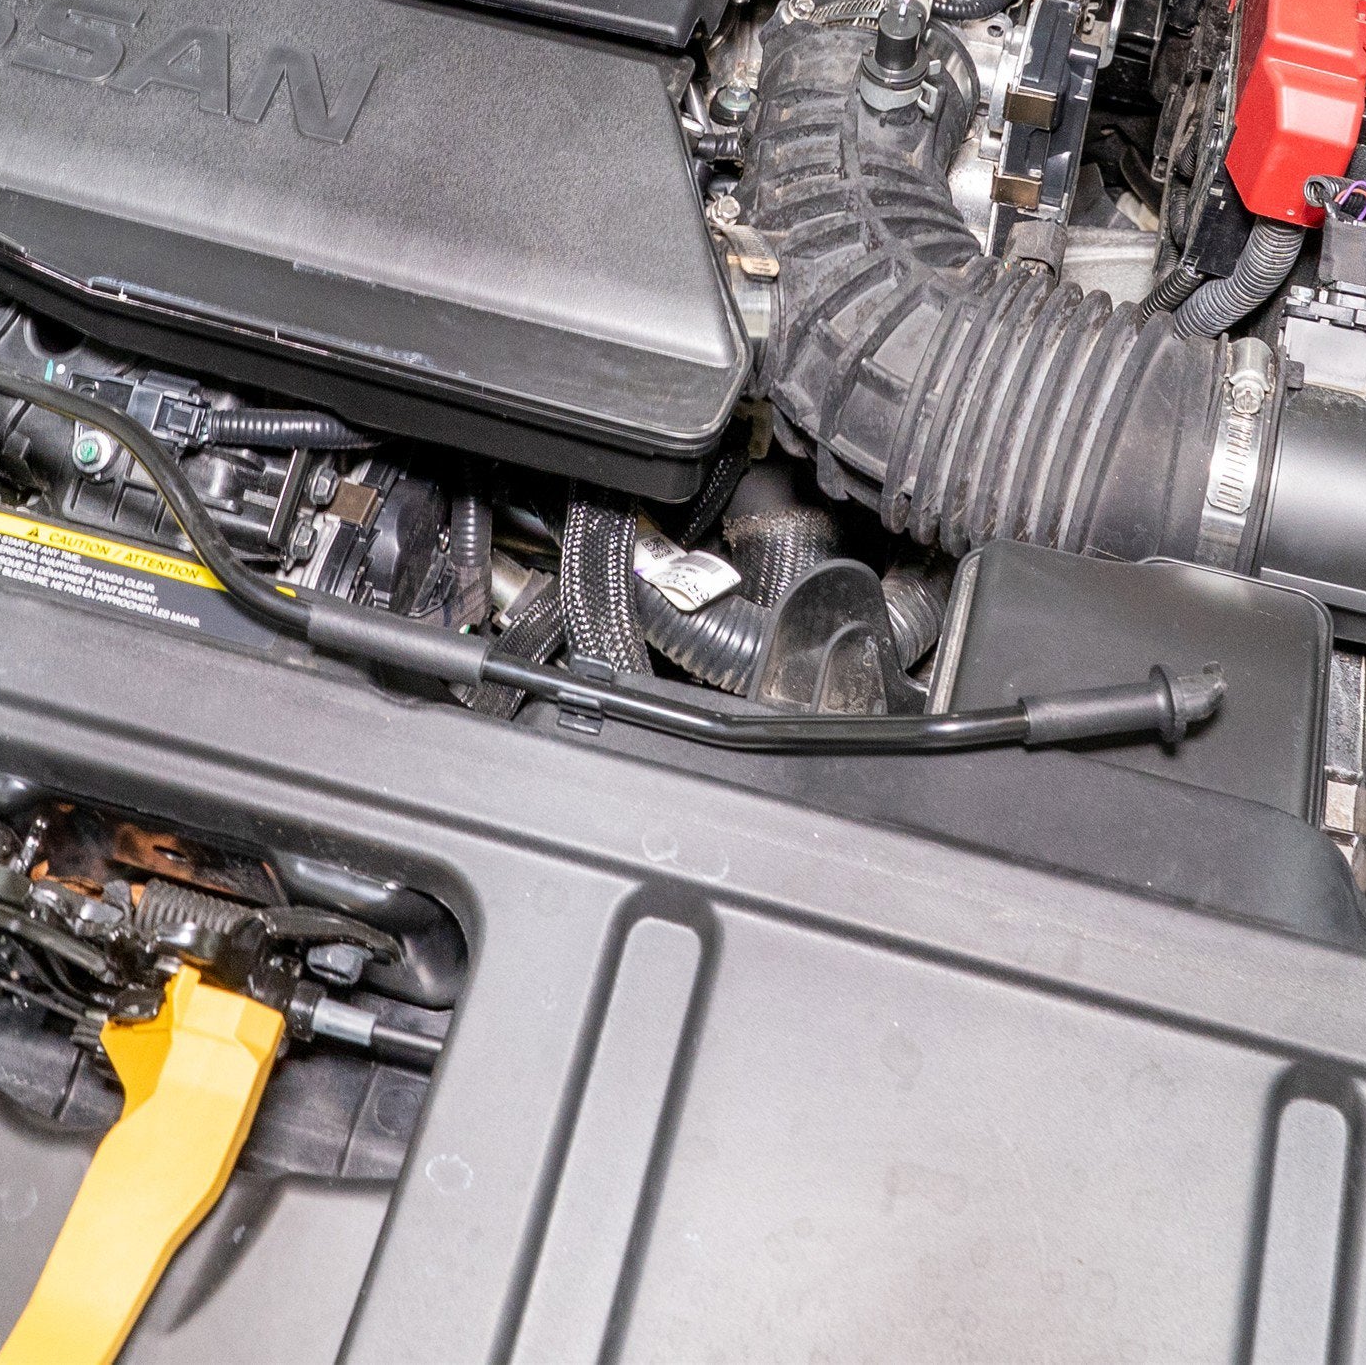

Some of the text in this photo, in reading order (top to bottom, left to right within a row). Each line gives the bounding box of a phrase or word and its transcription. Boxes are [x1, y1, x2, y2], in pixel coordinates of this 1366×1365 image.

[2, 534, 29, 549] START
[28, 542, 41, 552] AT
[40, 545, 61, 557] ANY
[49, 532, 110, 556] CAUTION
[124, 552, 200, 579] ATTENTION
[23, 561, 37, 573] DE
[37, 565, 86, 586] DÉMARRER
[95, 580, 118, 594] TOUT
[92, 568, 125, 585] HANDS
[50, 579, 64, 591] NE
[64, 583, 82, 596] PAS
[82, 588, 97, 600] EN
[96, 592, 153, 615] APPROCHER
[152, 604, 171, 619] LES
